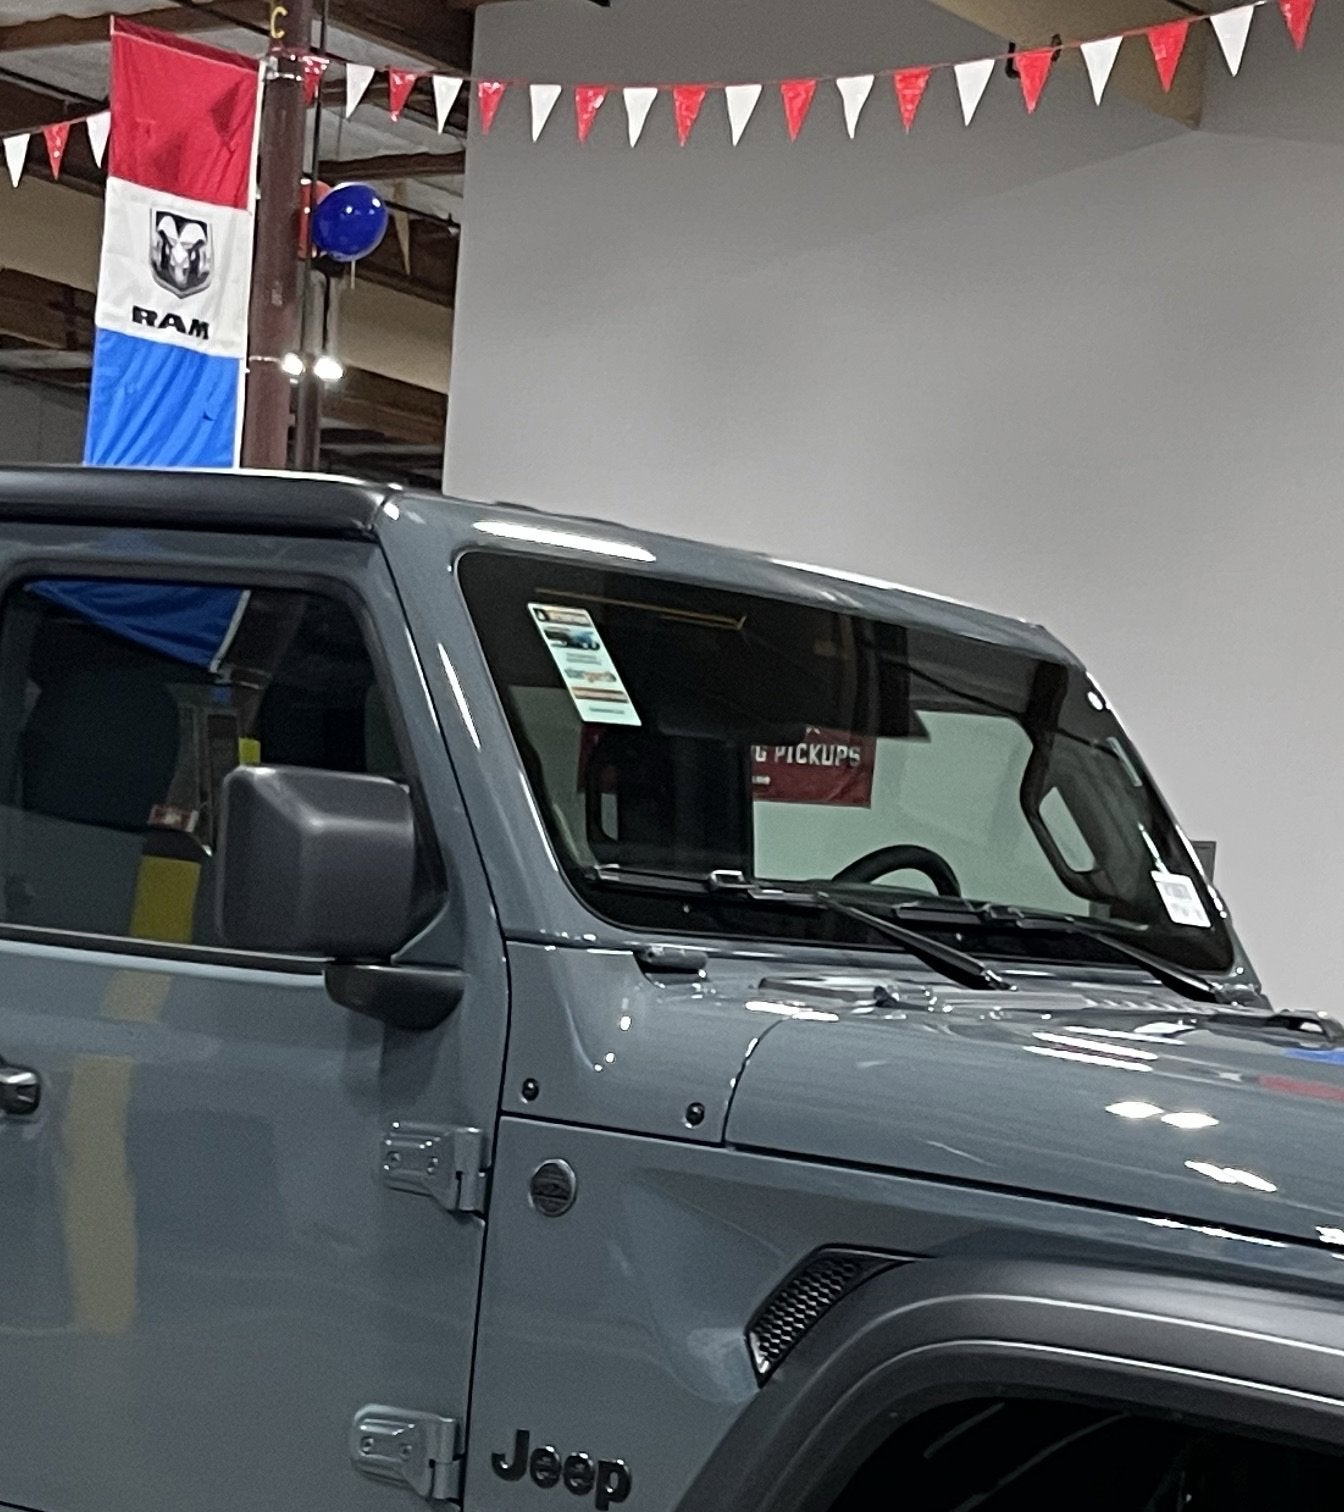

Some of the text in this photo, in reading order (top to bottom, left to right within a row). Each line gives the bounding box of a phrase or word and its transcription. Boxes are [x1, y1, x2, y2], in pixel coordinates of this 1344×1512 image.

[270, 6, 288, 38] C
[131, 305, 210, 340] RAM
[774, 742, 861, 767] PICKUPS
[491, 1428, 632, 1511] Jeep
